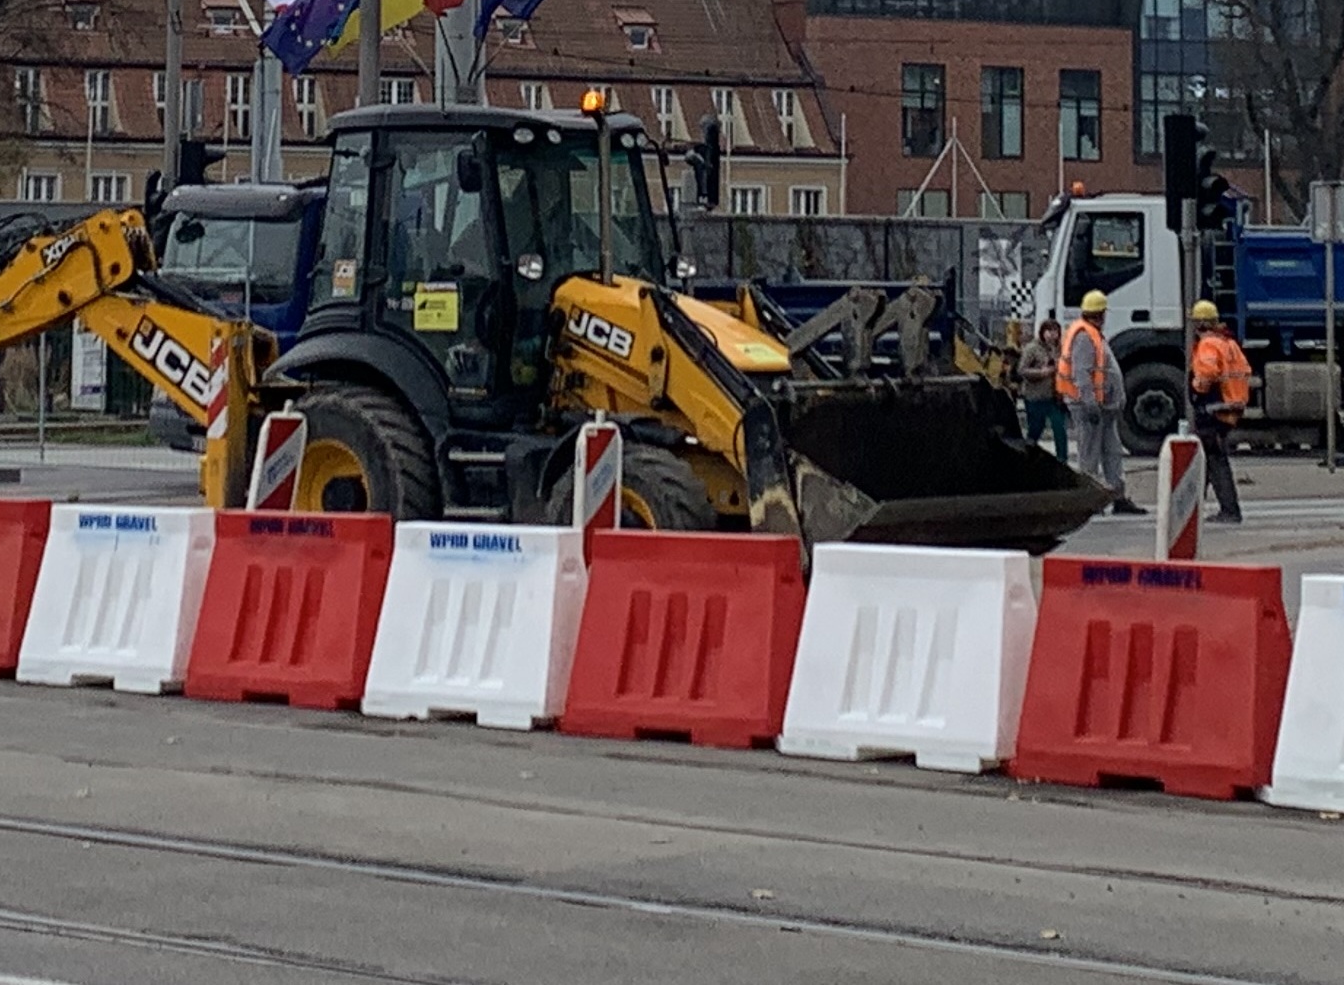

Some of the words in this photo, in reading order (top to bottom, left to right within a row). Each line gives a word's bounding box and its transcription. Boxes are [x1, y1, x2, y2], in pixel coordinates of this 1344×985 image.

[568, 312, 632, 357] JCB
[133, 329, 212, 405] JCB
[430, 532, 469, 549] WPRD
[473, 534, 523, 553] GRAVEL
